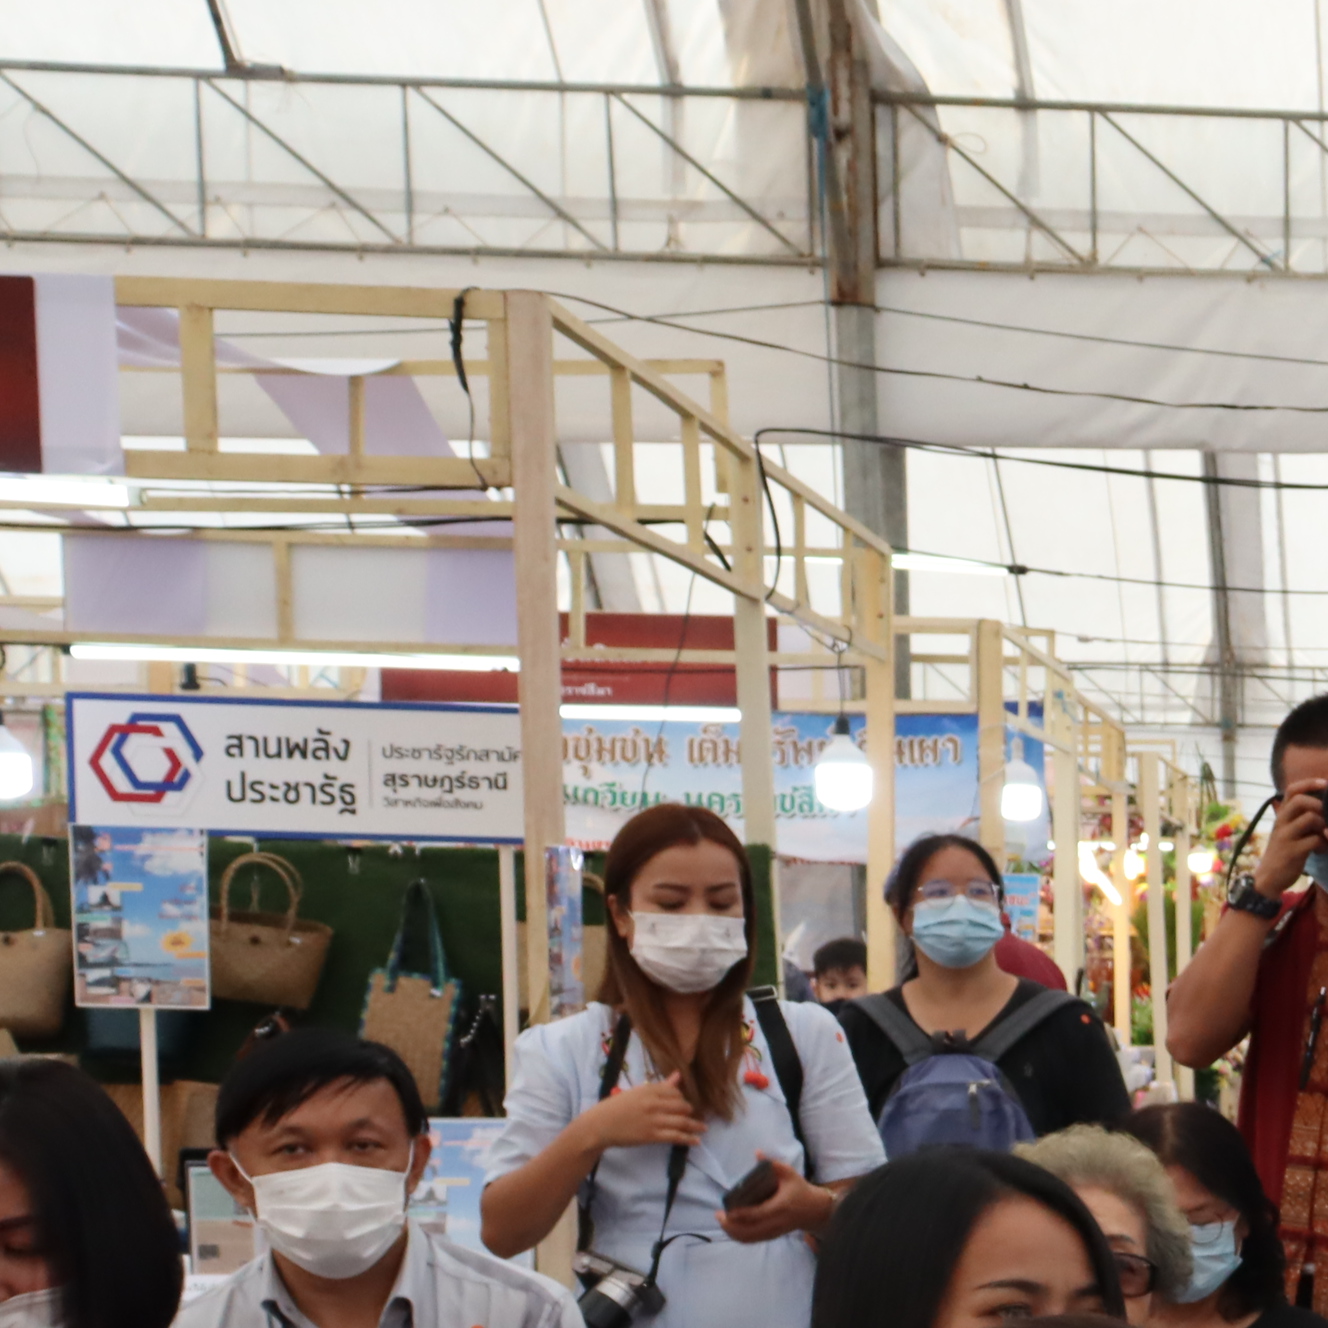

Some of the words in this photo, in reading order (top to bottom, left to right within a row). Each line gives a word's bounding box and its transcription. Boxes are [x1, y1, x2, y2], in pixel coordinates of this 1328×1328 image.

[224, 727, 351, 762] สานพลัง
[225, 771, 357, 816] ประชารัฐ
[383, 771, 508, 794] สุราษฎร์ธานี
